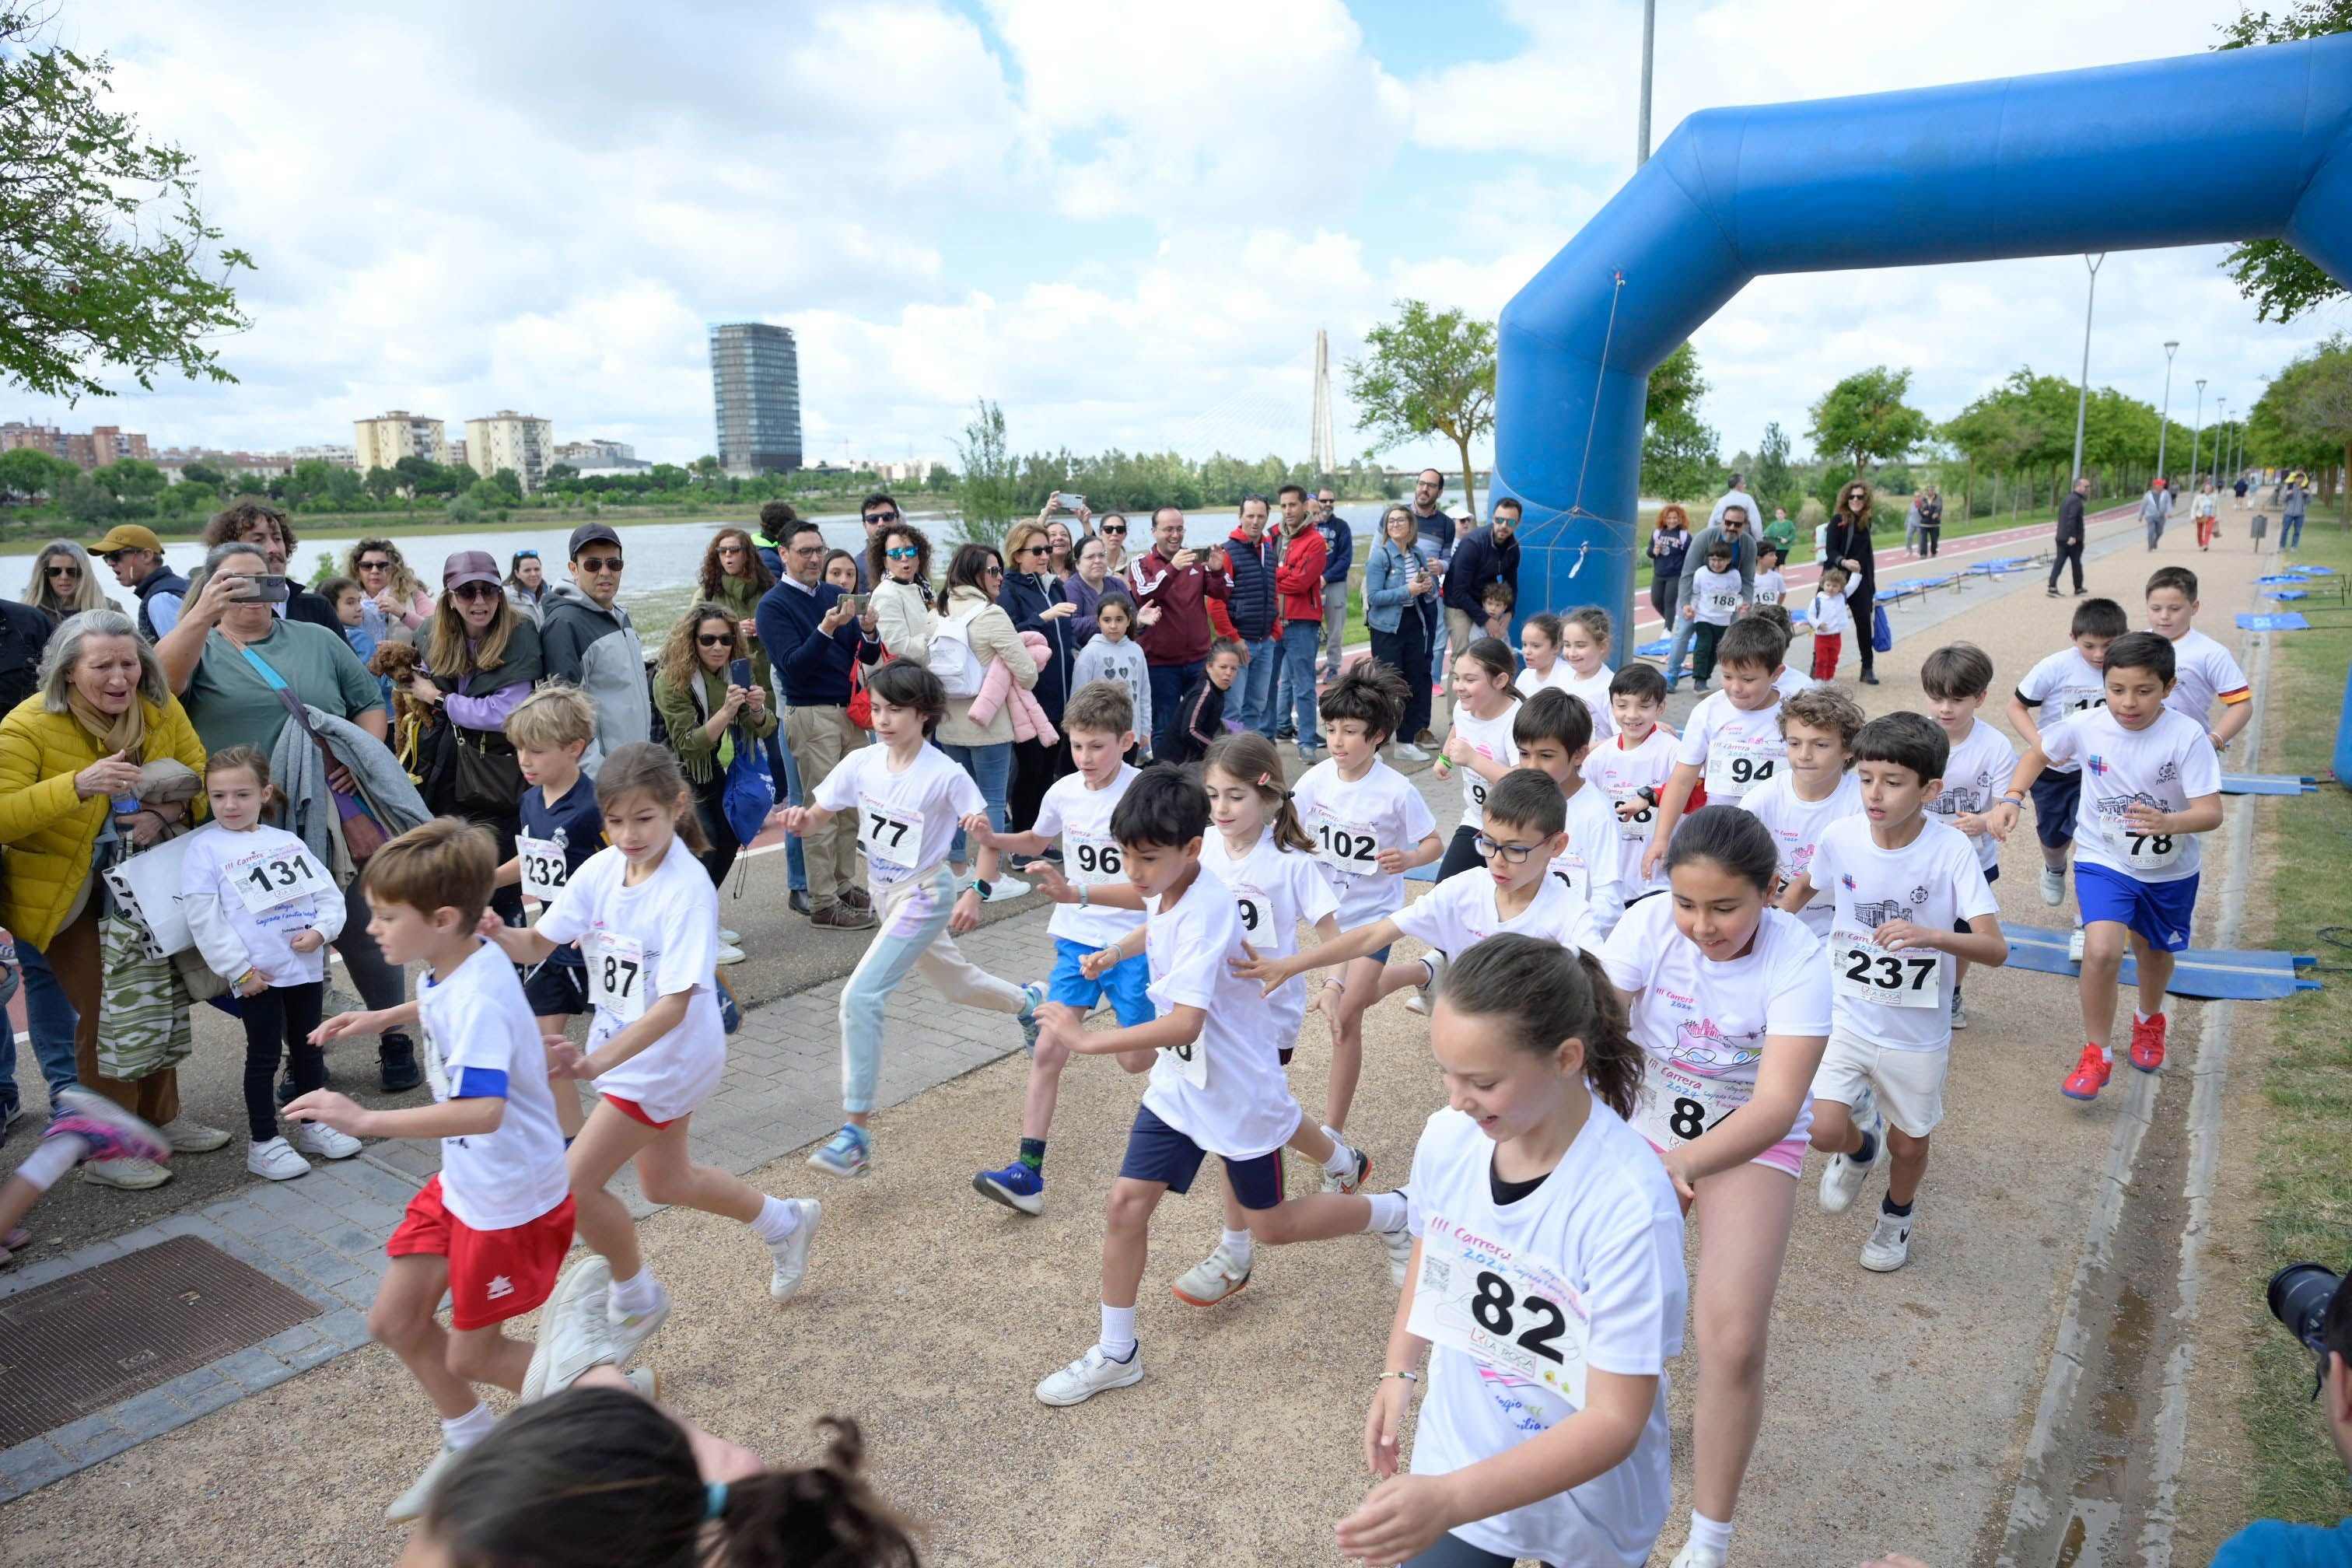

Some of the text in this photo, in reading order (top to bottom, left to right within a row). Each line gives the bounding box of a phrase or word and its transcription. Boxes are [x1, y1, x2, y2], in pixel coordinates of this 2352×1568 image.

[1713, 594, 1735, 607] 188
[1731, 758, 1774, 783] 94
[870, 813, 908, 848] 77
[1319, 824, 1376, 861] 102
[2125, 831, 2173, 856] 78
[236, 852, 264, 866] Carrera
[248, 855, 313, 892] 131
[525, 854, 566, 887] 232
[1078, 845, 1122, 874] 96
[604, 955, 638, 998] 87
[1846, 950, 1937, 990] 237
[1656, 988, 1694, 1004] III Carrera
[1671, 1001, 1693, 1011] 2024
[1648, 1058, 1703, 1090] III Carrera
[1667, 1082, 1700, 1099] 2024
[1430, 1216, 1512, 1262] III Carrera
[1461, 1248, 1509, 1274] 2024
[1472, 1271, 1566, 1366] 82
[1501, 1345, 1534, 1370] ROCA
